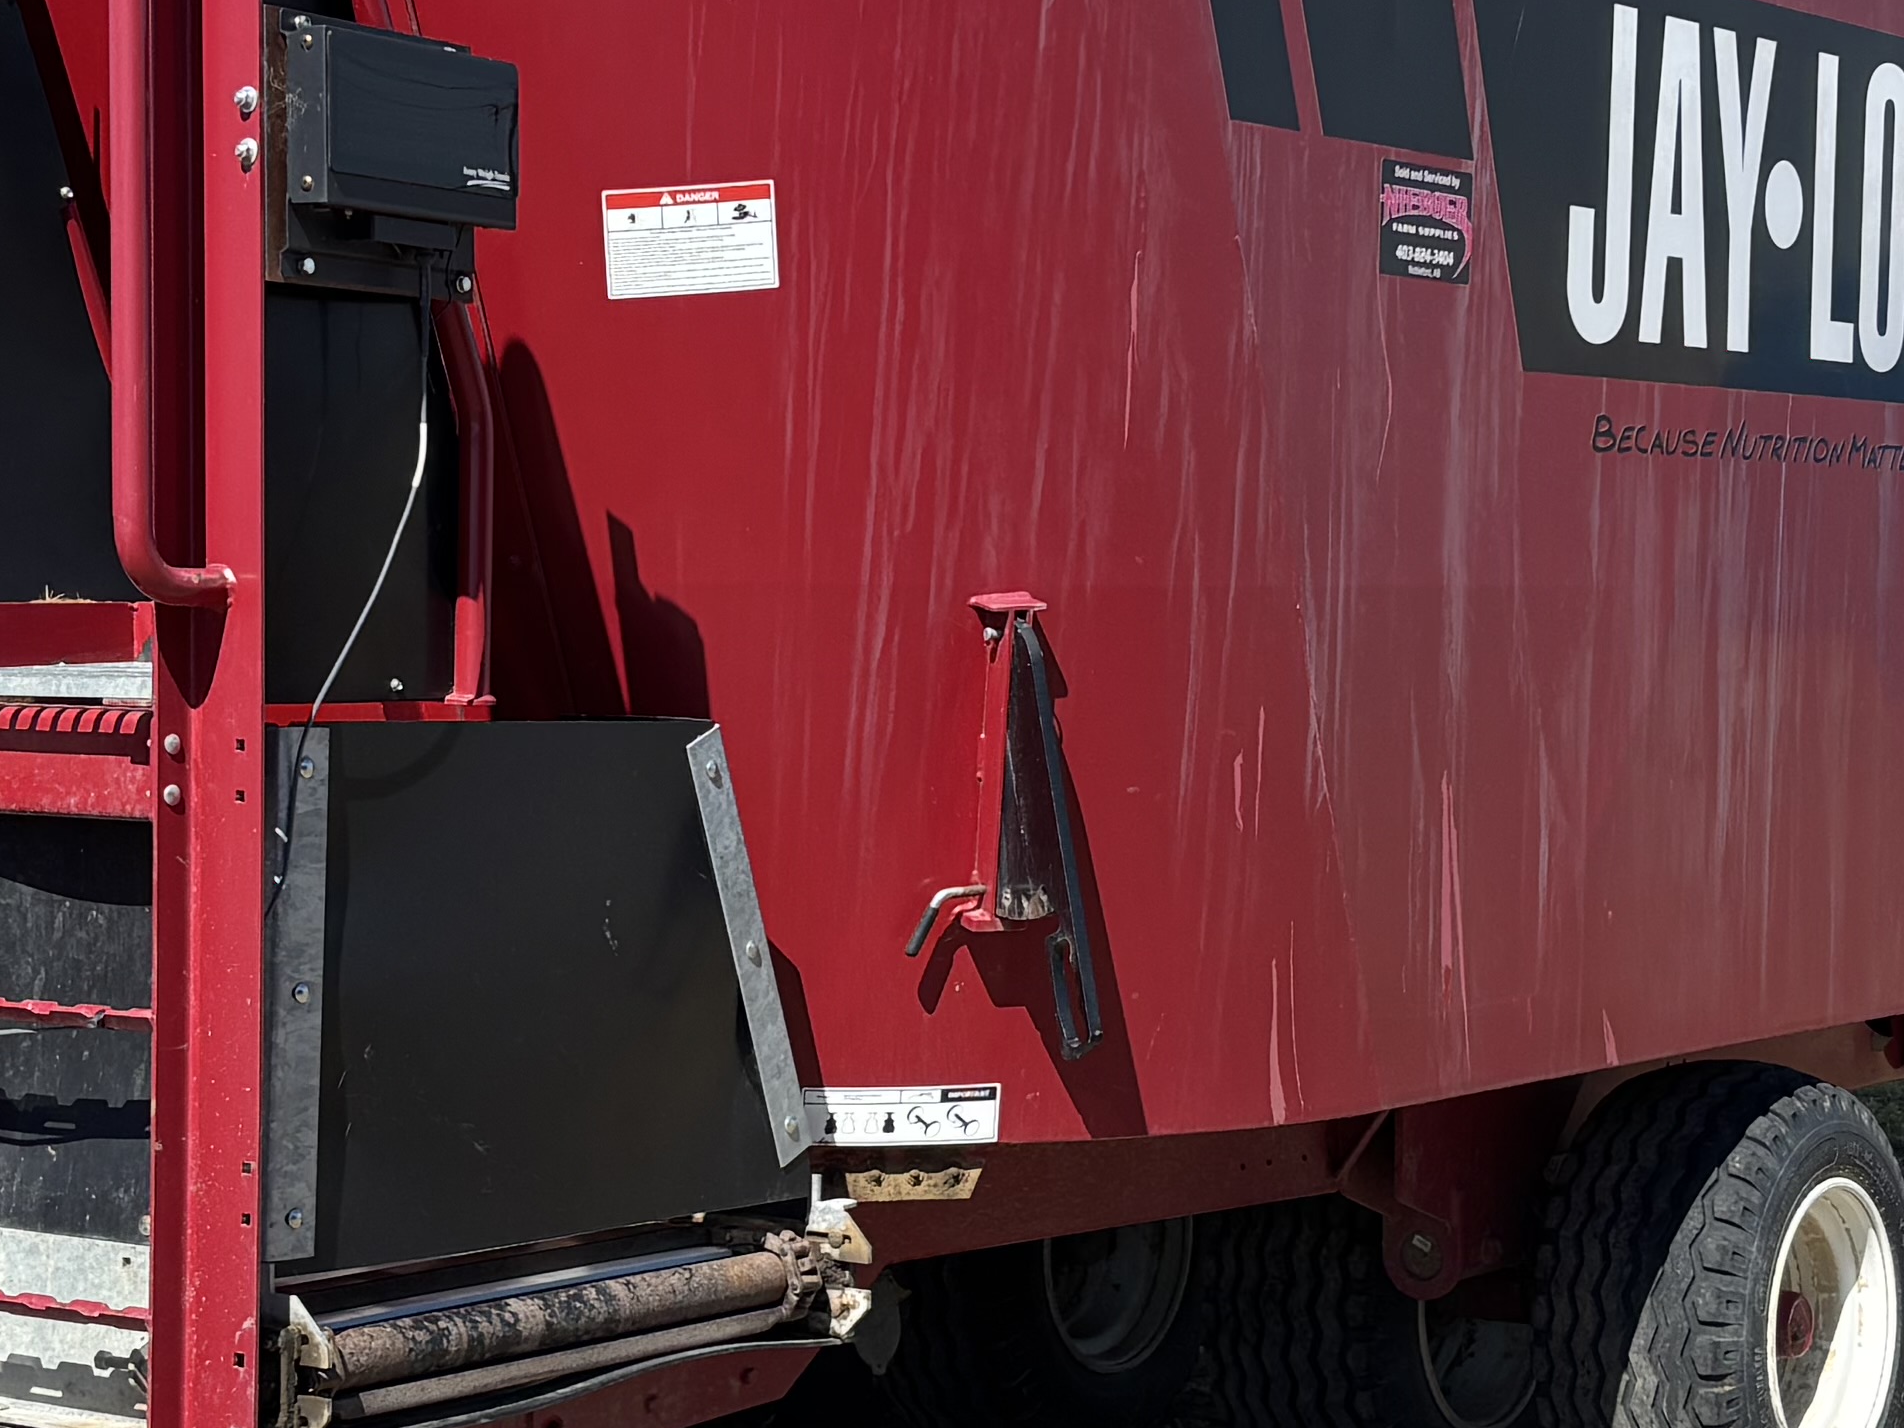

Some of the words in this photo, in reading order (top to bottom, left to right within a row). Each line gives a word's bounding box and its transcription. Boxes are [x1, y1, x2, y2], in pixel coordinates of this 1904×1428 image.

[1394, 165, 1410, 179] Sold
[1410, 170, 1423, 182] and
[1424, 170, 1451, 185] Serviced
[1451, 175, 1461, 190] by
[676, 191, 719, 203] DANGER
[1392, 222, 1416, 234] FARM
[1418, 226, 1458, 241] SUPPLIES
